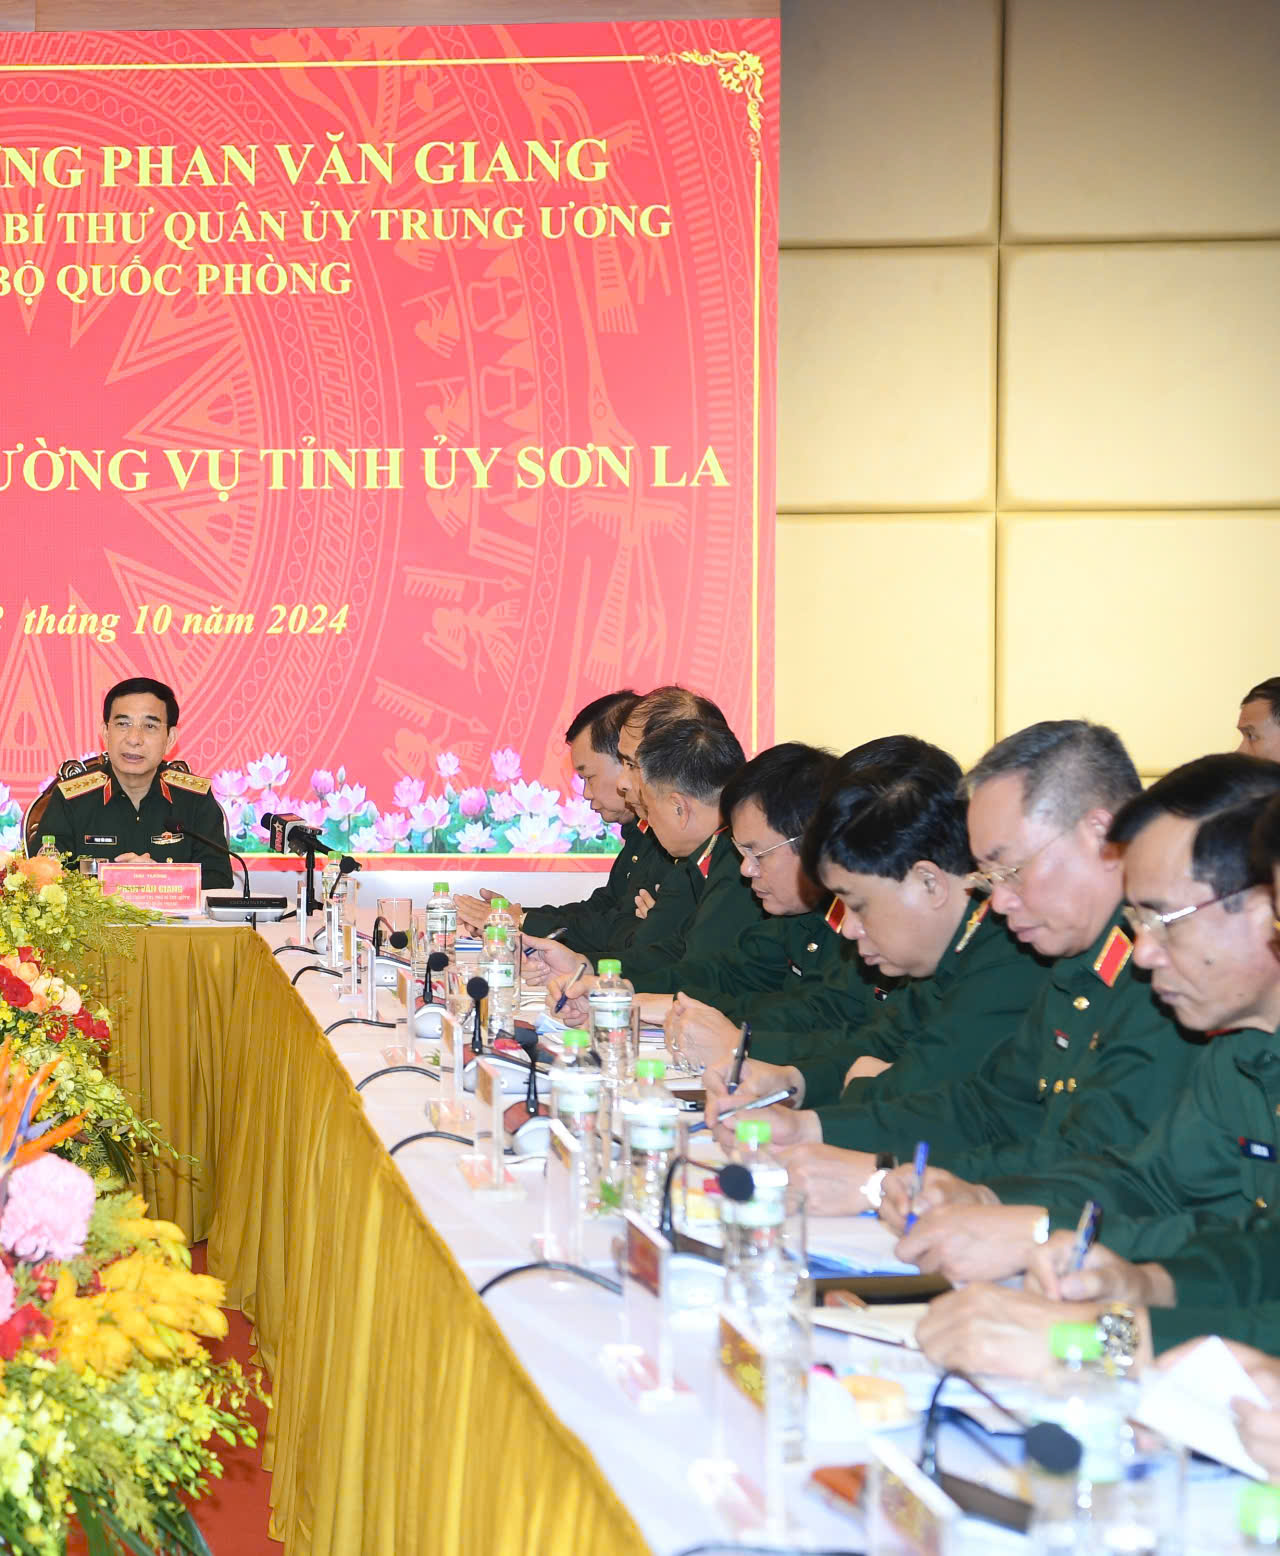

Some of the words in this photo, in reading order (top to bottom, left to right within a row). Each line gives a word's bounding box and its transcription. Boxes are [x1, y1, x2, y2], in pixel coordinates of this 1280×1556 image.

[100, 145, 265, 188] PHAN
[274, 131, 395, 186] VĂN
[414, 138, 610, 184] GIANG
[3, 203, 47, 245] BÍ
[57, 206, 154, 244] THƯ
[163, 203, 287, 251] QUÂN
[302, 200, 361, 242] ỦY
[372, 207, 525, 241] TRUNG
[540, 203, 673, 239] ƯƠNG
[56, 257, 183, 304] QUỐC
[195, 255, 353, 296] PHÒNG
[163, 448, 245, 503] VỤ
[259, 435, 405, 490] TỈNH
[421, 434, 503, 490] ỦY
[516, 442, 635, 489] SƠN
[650, 445, 731, 488] LA
[23, 603, 121, 644] tháng
[132, 604, 173, 635] 10
[181, 605, 255, 635] năm
[266, 603, 350, 635] 2024
